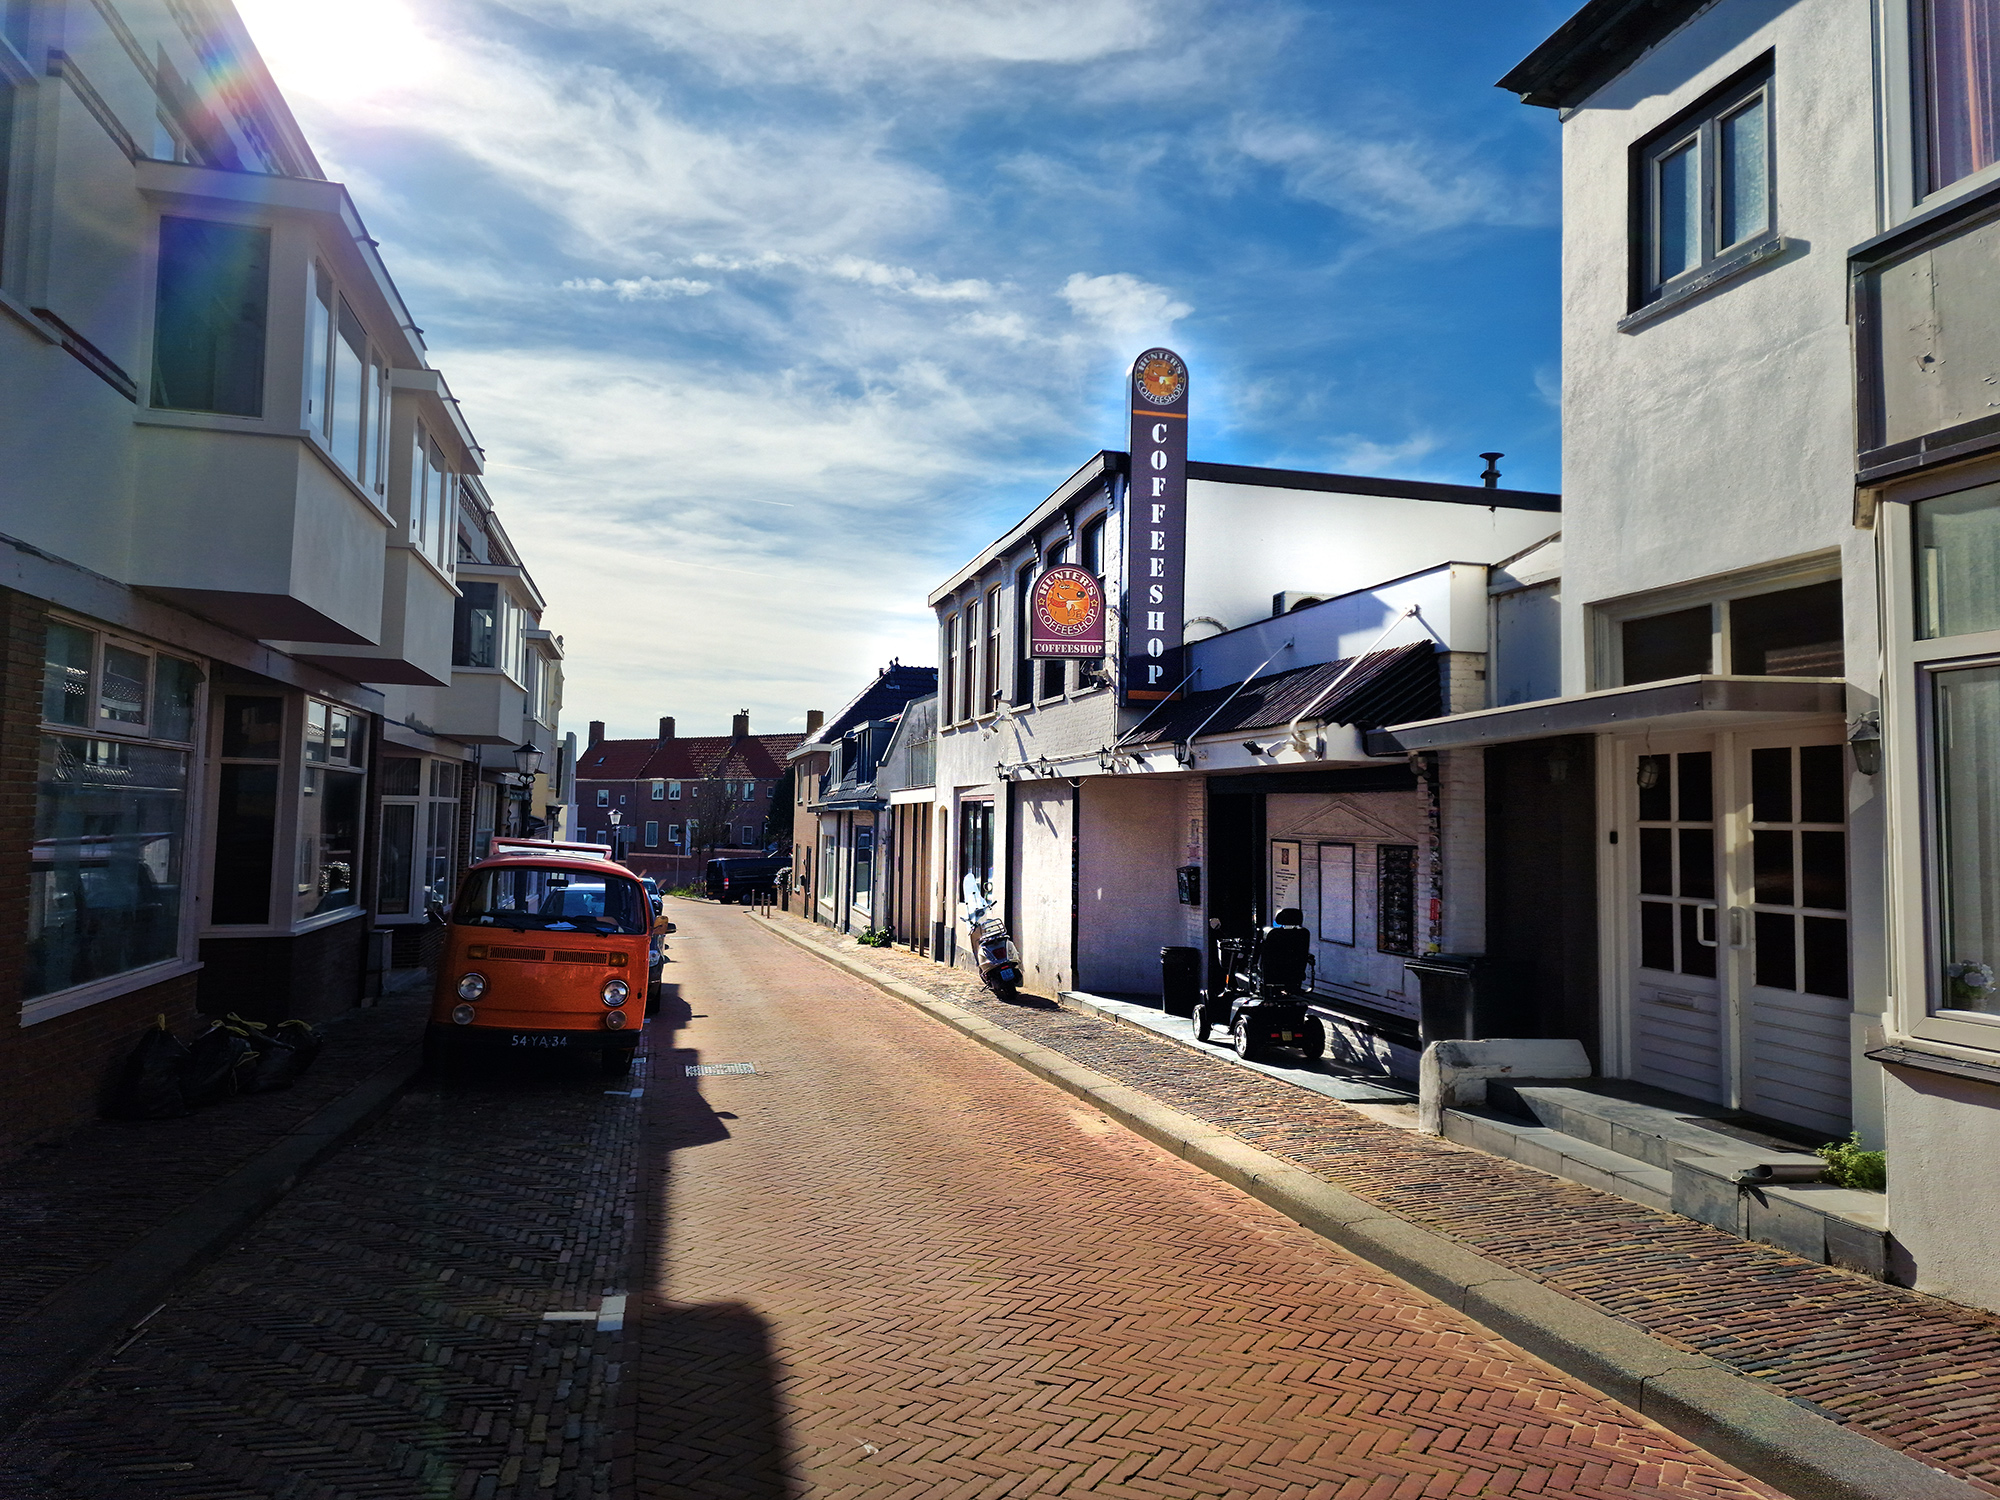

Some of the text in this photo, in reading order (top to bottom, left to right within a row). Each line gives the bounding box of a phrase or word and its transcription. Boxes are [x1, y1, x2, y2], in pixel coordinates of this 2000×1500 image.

[1137, 380, 1182, 403] COFFEESHOP
[1147, 423, 1168, 684] COFFEESHOP
[1039, 571, 1096, 596] HUNTER'S
[1039, 607, 1096, 635] COFFEESHOP
[1034, 643, 1103, 654] COFFEESHOP
